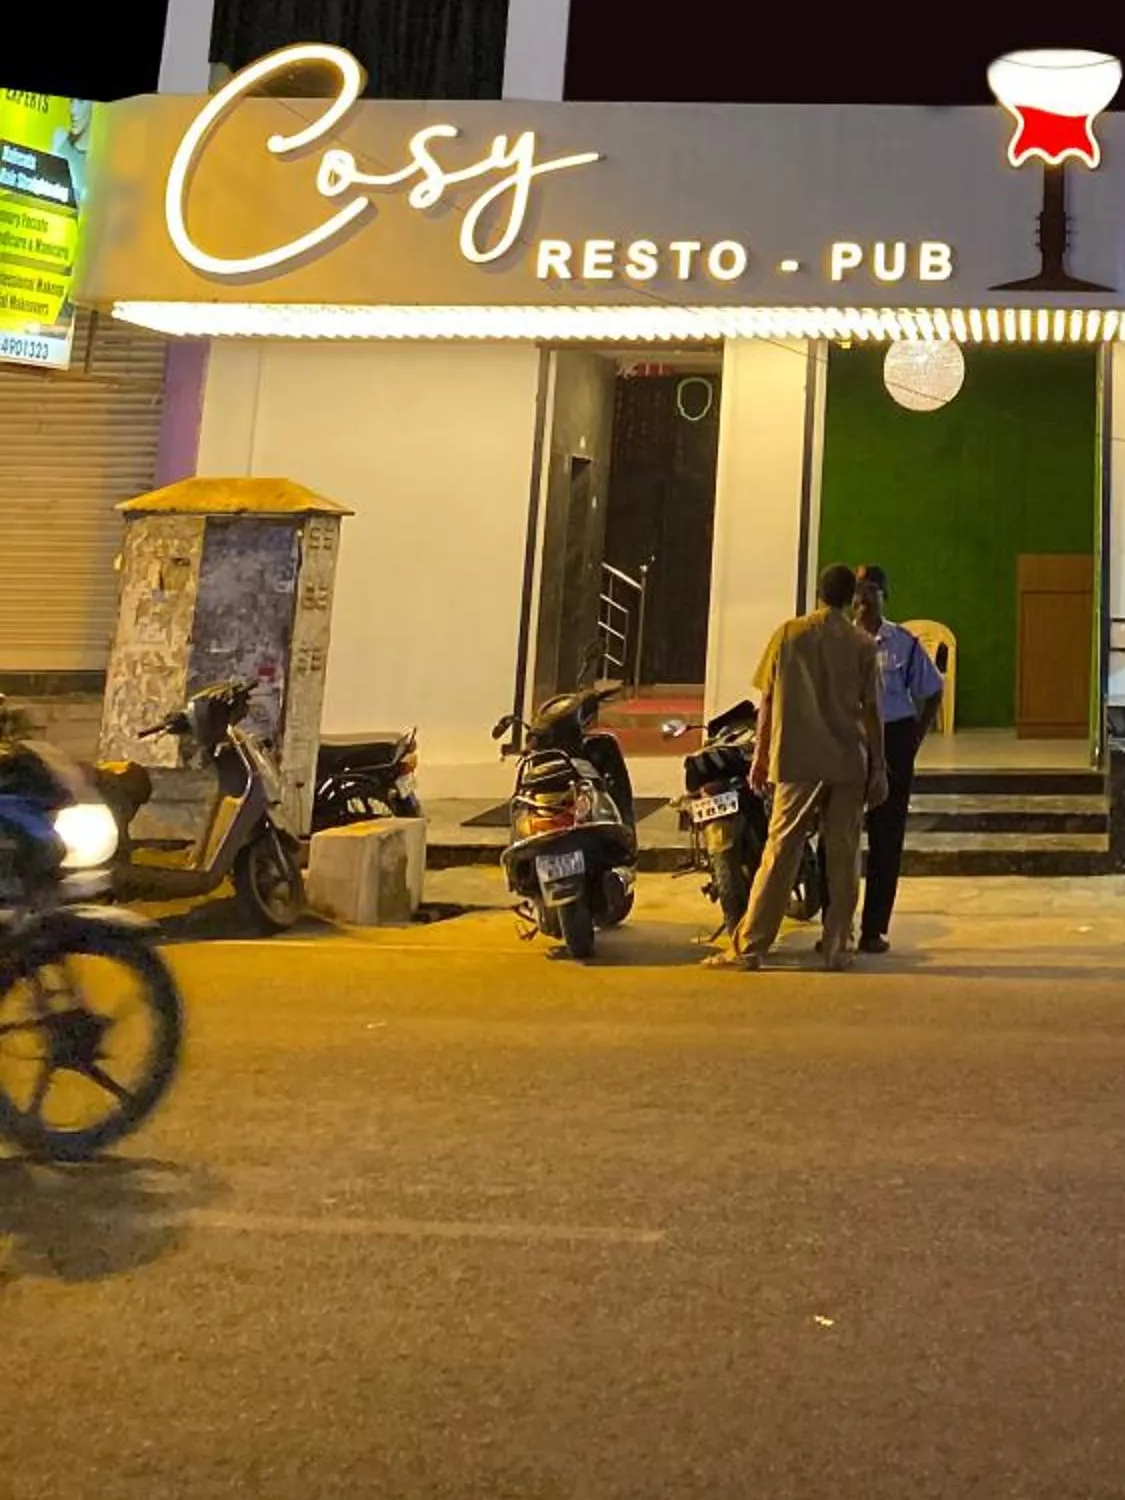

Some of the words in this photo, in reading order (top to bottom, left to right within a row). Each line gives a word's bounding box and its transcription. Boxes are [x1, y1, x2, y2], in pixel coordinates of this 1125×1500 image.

[166, 43, 602, 275] Cosy
[536, 240, 747, 281] RESTO
[831, 242, 955, 282] PUB
